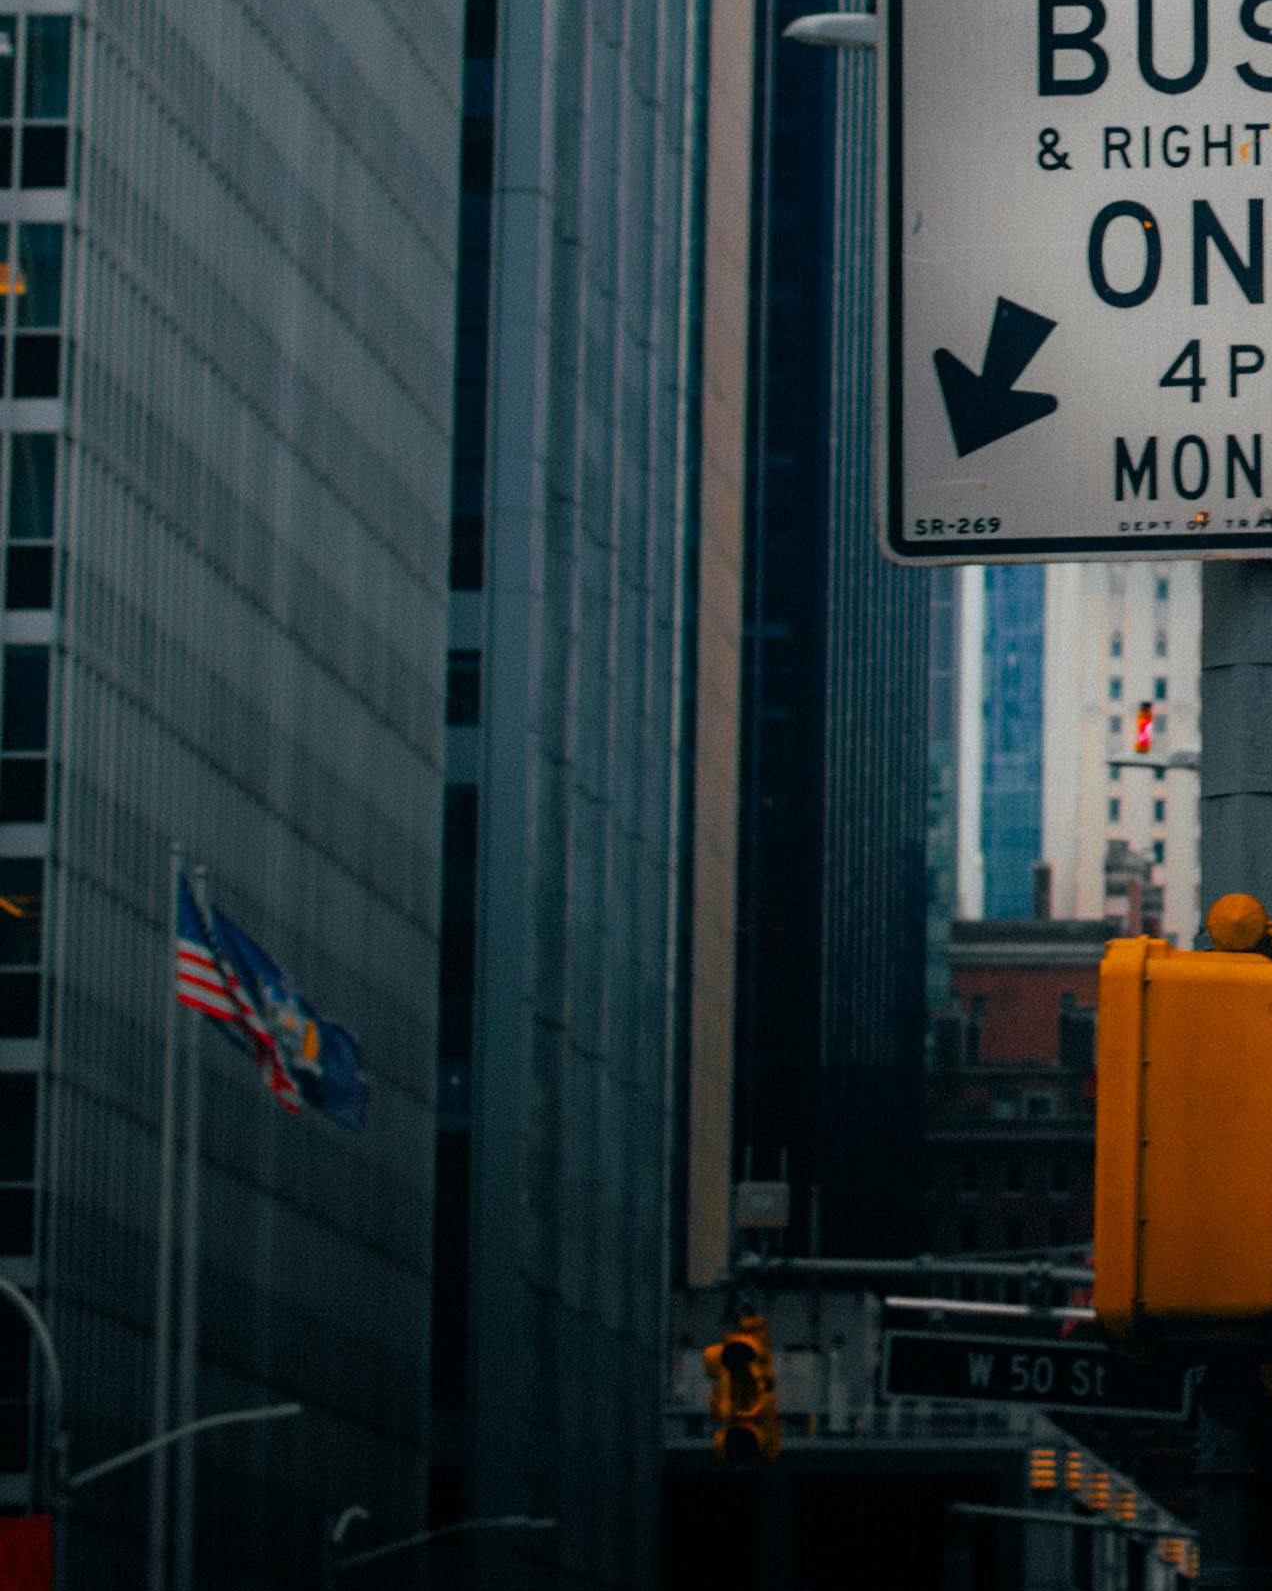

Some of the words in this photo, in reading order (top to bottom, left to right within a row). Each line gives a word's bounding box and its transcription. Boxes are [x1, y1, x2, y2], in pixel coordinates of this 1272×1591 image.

[1037, 127, 1073, 171] &
[1103, 121, 1272, 171] RIGHT
[1114, 433, 1263, 502] MON
[914, 516, 1001, 536] SR-269
[1119, 519, 1173, 533] DEPT
[967, 1352, 995, 1389] W
[1008, 1354, 1055, 1395] 50
[1070, 1357, 1108, 1398] St
